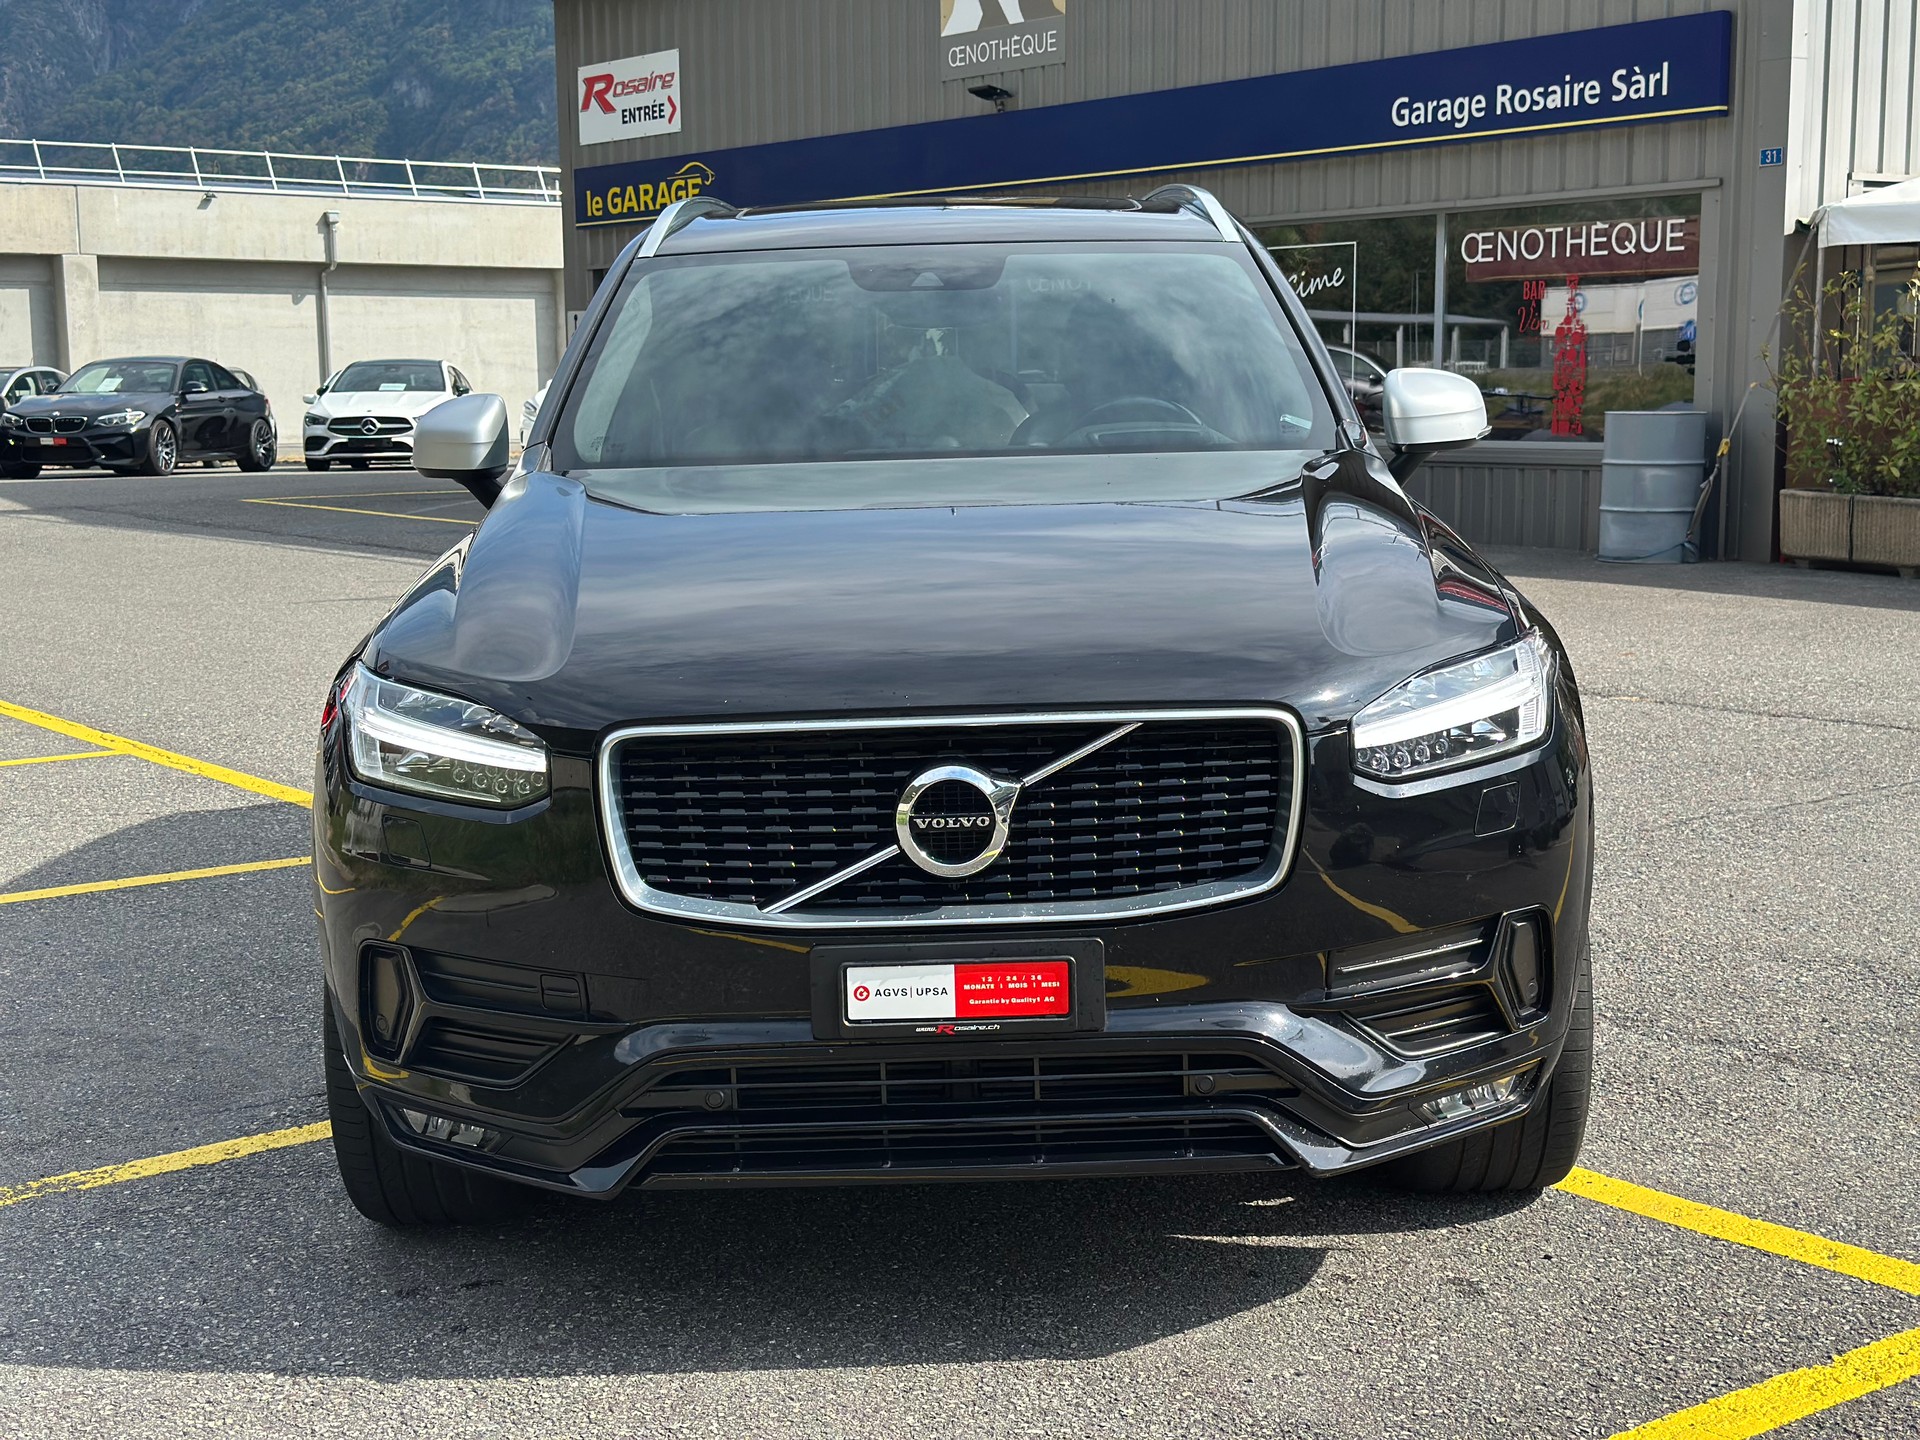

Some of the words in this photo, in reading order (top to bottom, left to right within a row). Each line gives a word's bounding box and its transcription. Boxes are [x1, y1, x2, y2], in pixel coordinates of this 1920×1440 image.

[948, 30, 1057, 67] ŒNOTHÈQUE
[580, 71, 676, 114] Rosaire
[1391, 94, 1486, 129] Garage
[1496, 74, 1601, 116] Rosaire
[1611, 61, 1669, 102] Sàrl
[621, 99, 666, 124] ENTRÉE
[1765, 150, 1777, 163] 31
[586, 190, 603, 217] le
[607, 178, 703, 215] GARAGE
[1461, 219, 1686, 264] ŒNOTHÈQUE
[1288, 267, 1345, 298] ime
[1523, 280, 1546, 300] BAR
[913, 816, 990, 829] VOLVO
